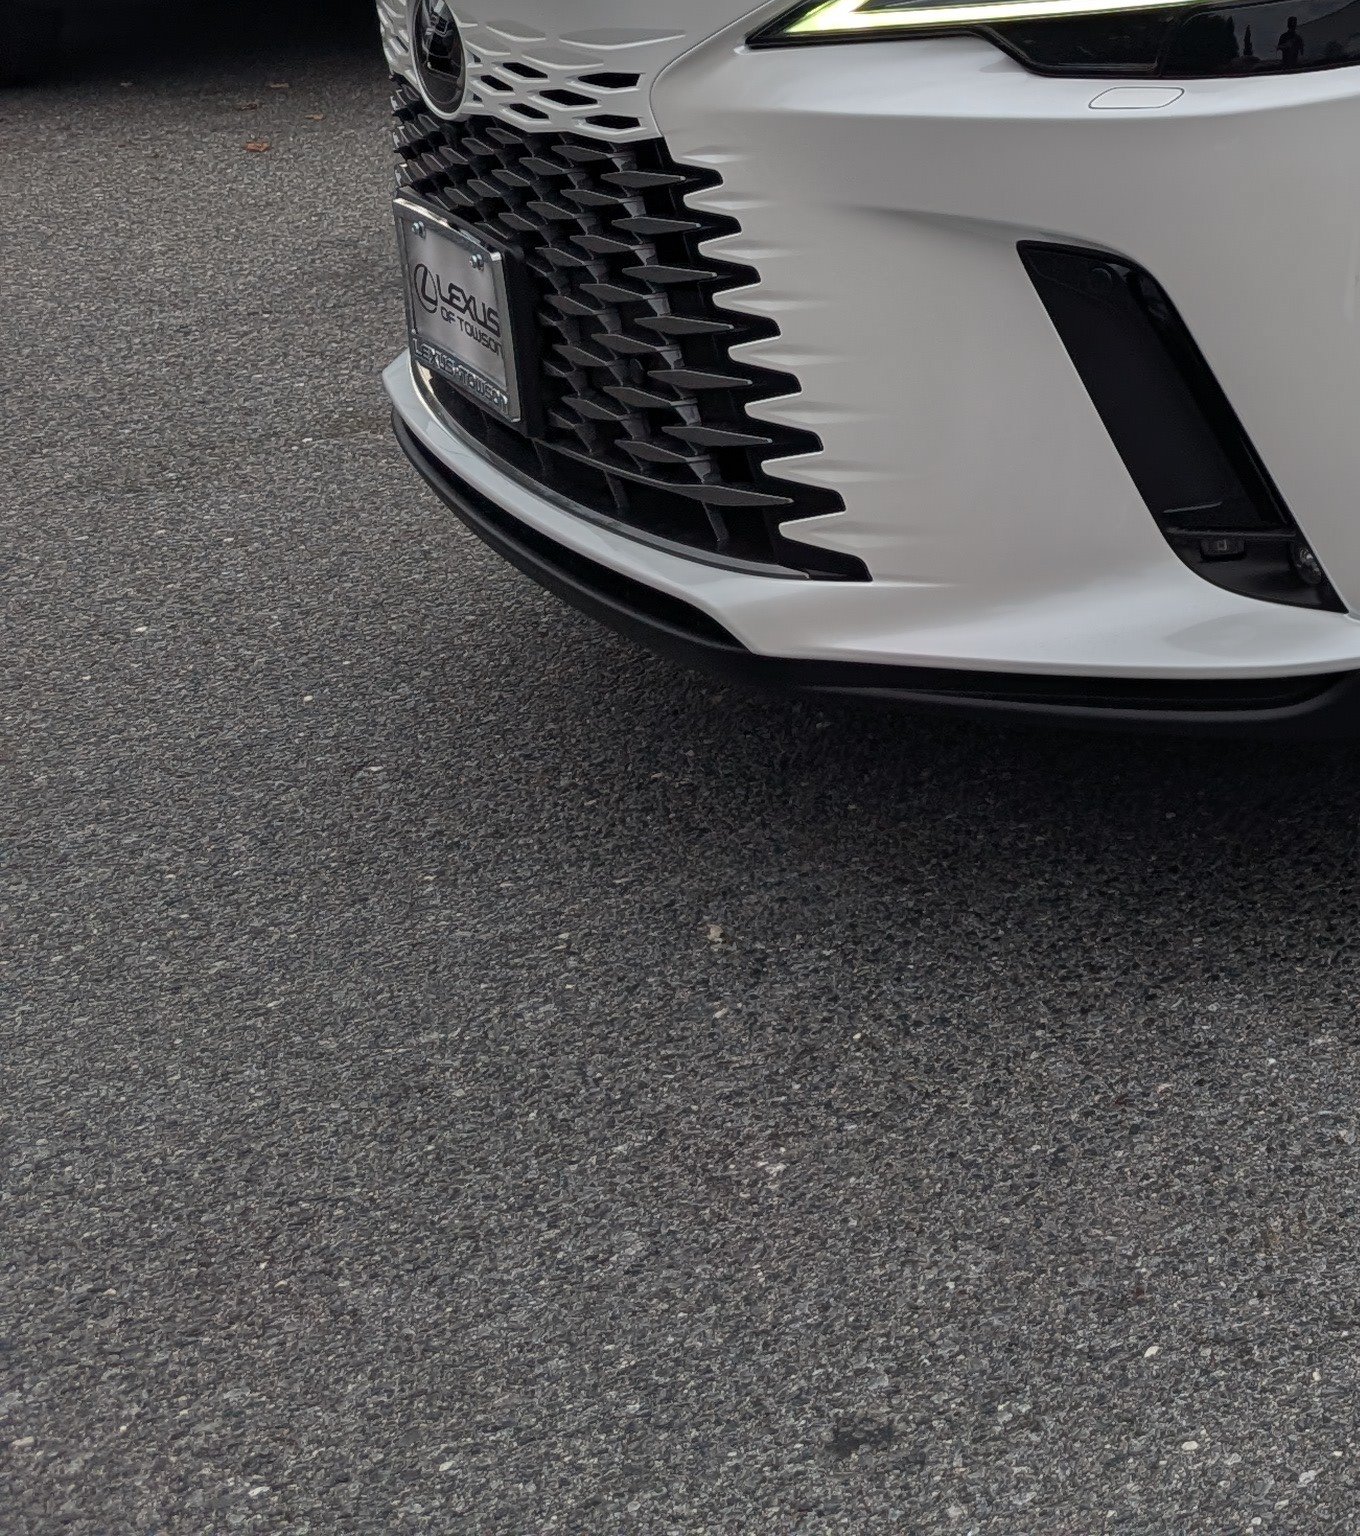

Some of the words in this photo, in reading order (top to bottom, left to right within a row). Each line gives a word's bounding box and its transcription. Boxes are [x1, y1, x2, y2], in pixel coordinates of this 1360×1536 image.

[436, 273, 501, 338] LEXUS
[440, 305, 456, 324] OF
[412, 337, 456, 375] LEXUS
